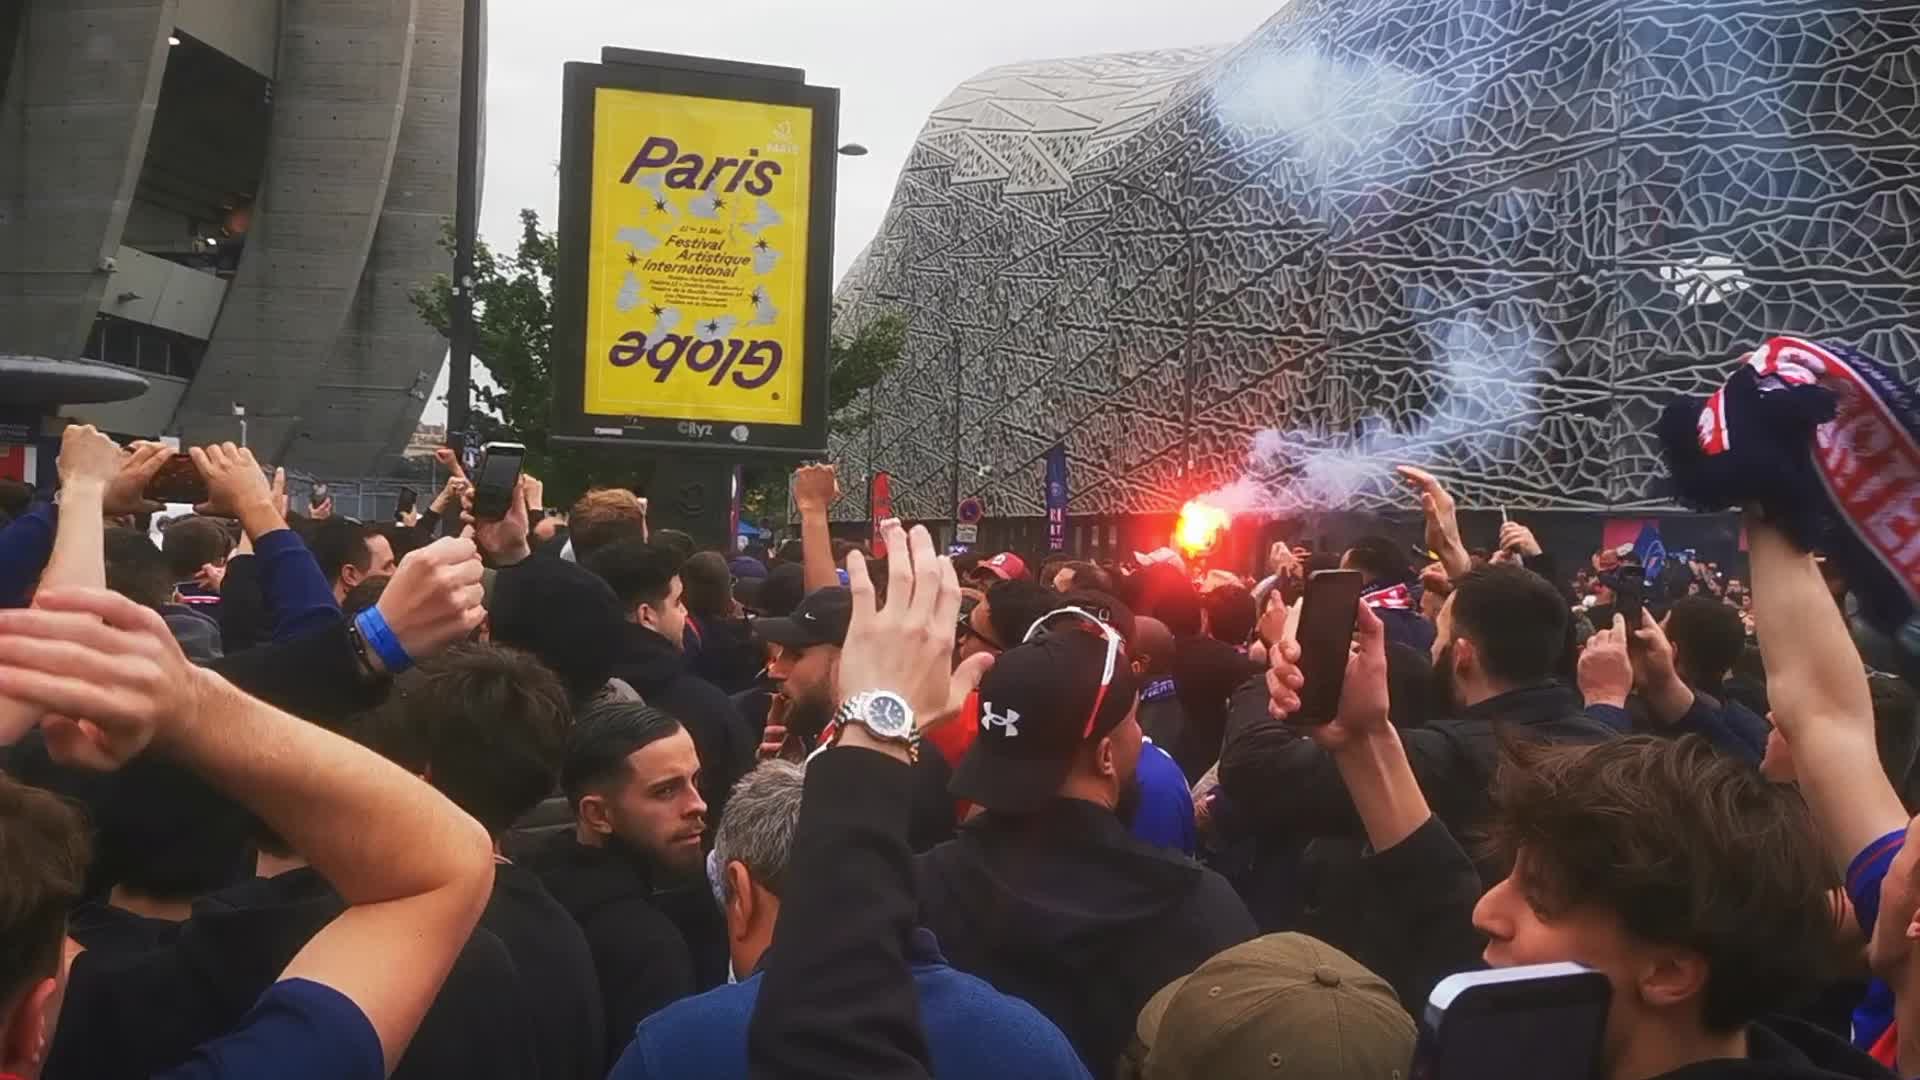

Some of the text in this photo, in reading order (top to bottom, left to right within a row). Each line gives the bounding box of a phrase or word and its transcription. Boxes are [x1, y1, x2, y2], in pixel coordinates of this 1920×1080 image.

[619, 136, 782, 196] Paris
[665, 234, 725, 251] Festival
[676, 249, 751, 266] Artistique
[643, 259, 738, 277] International
[609, 331, 783, 389] Globe
